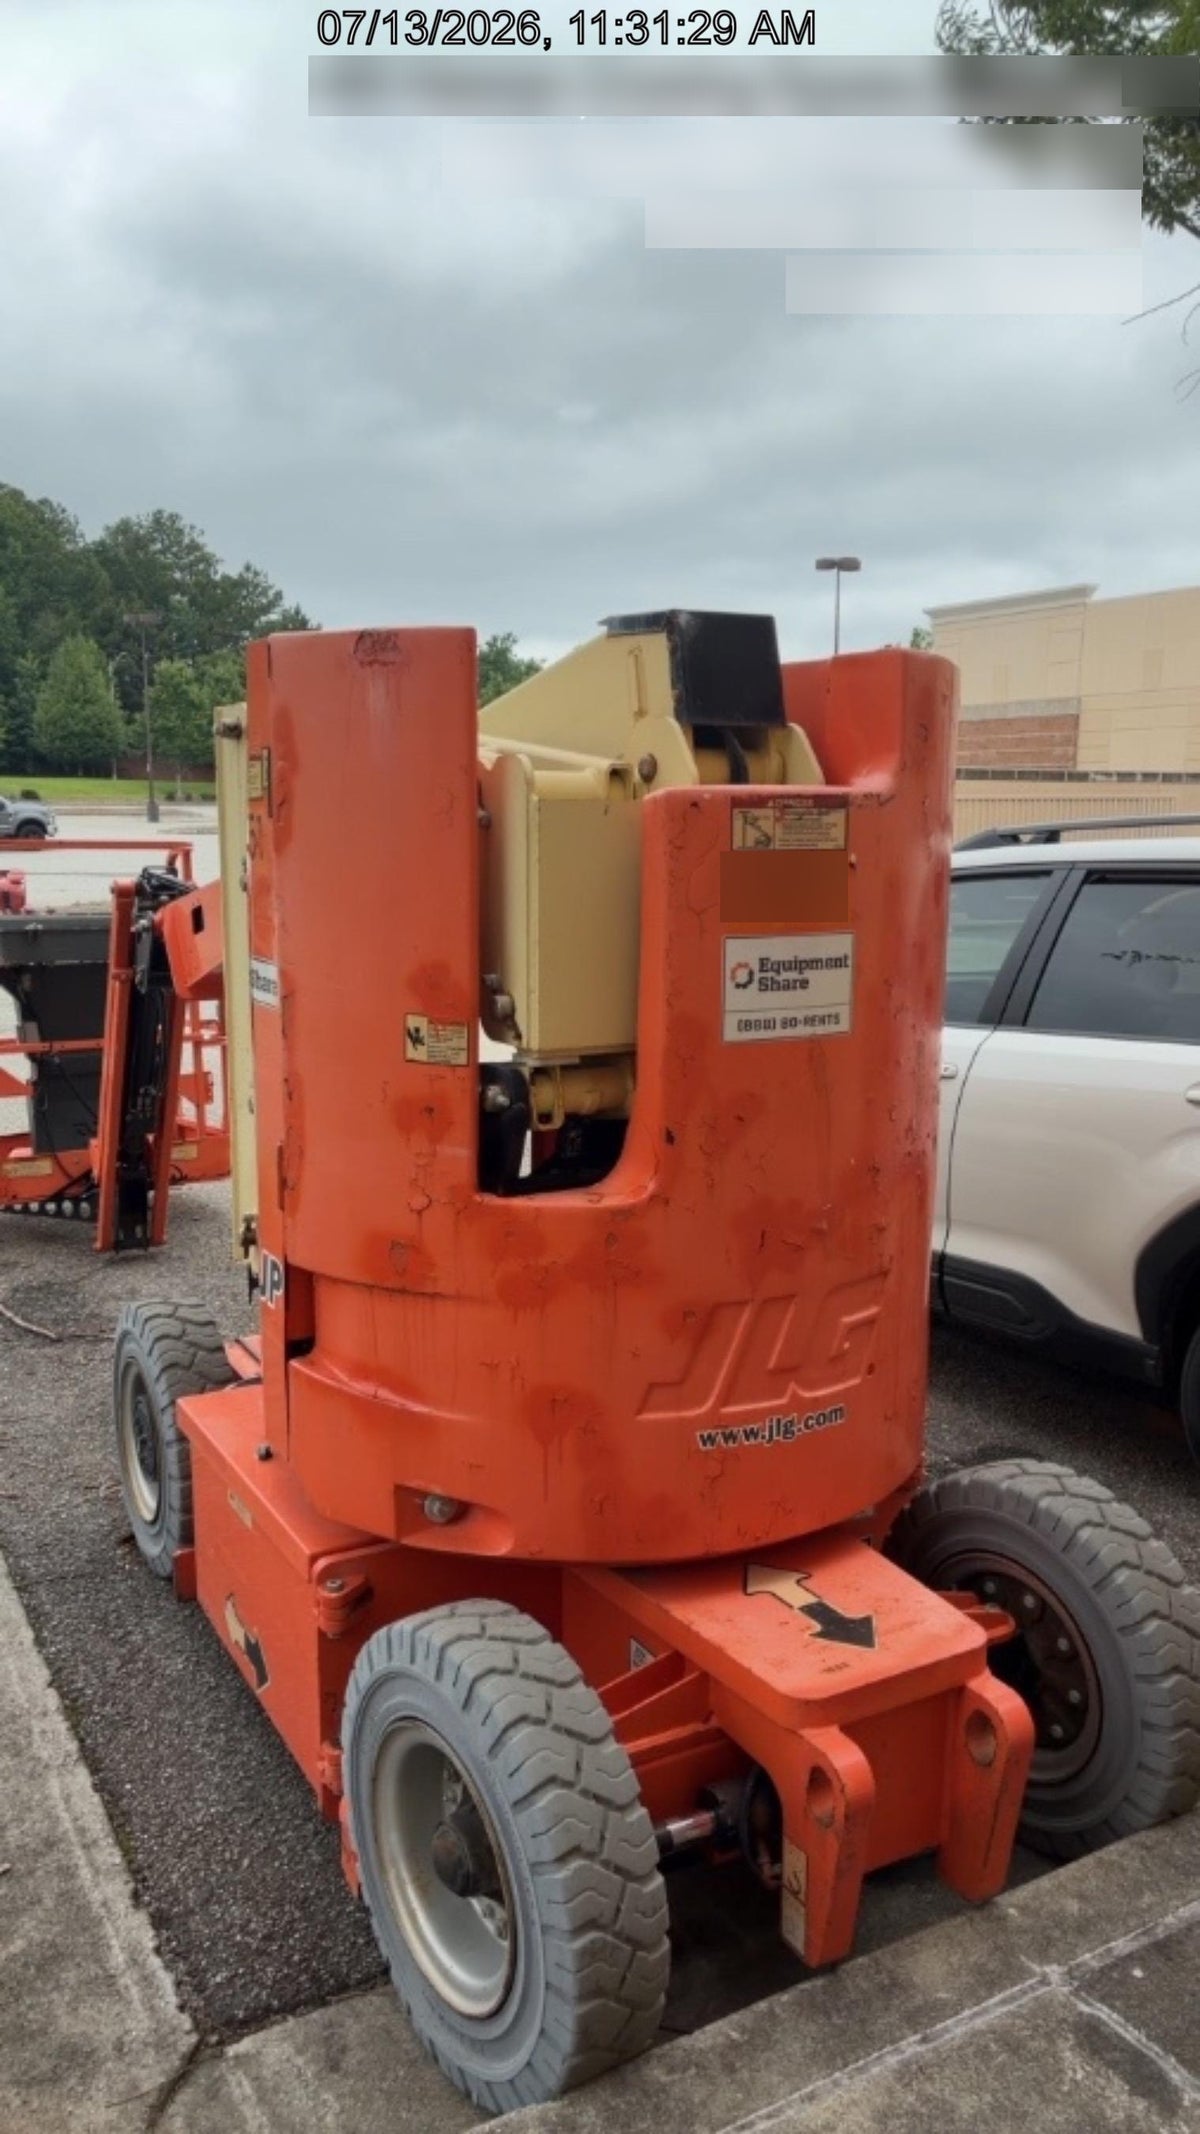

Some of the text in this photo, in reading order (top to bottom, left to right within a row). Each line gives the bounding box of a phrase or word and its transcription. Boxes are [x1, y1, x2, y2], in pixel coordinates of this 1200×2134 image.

[758, 954, 850, 976] Equipment
[758, 976, 810, 992] Share
[636, 1268, 889, 1420] JLG
[697, 1404, 845, 1449] www.jlg.com
